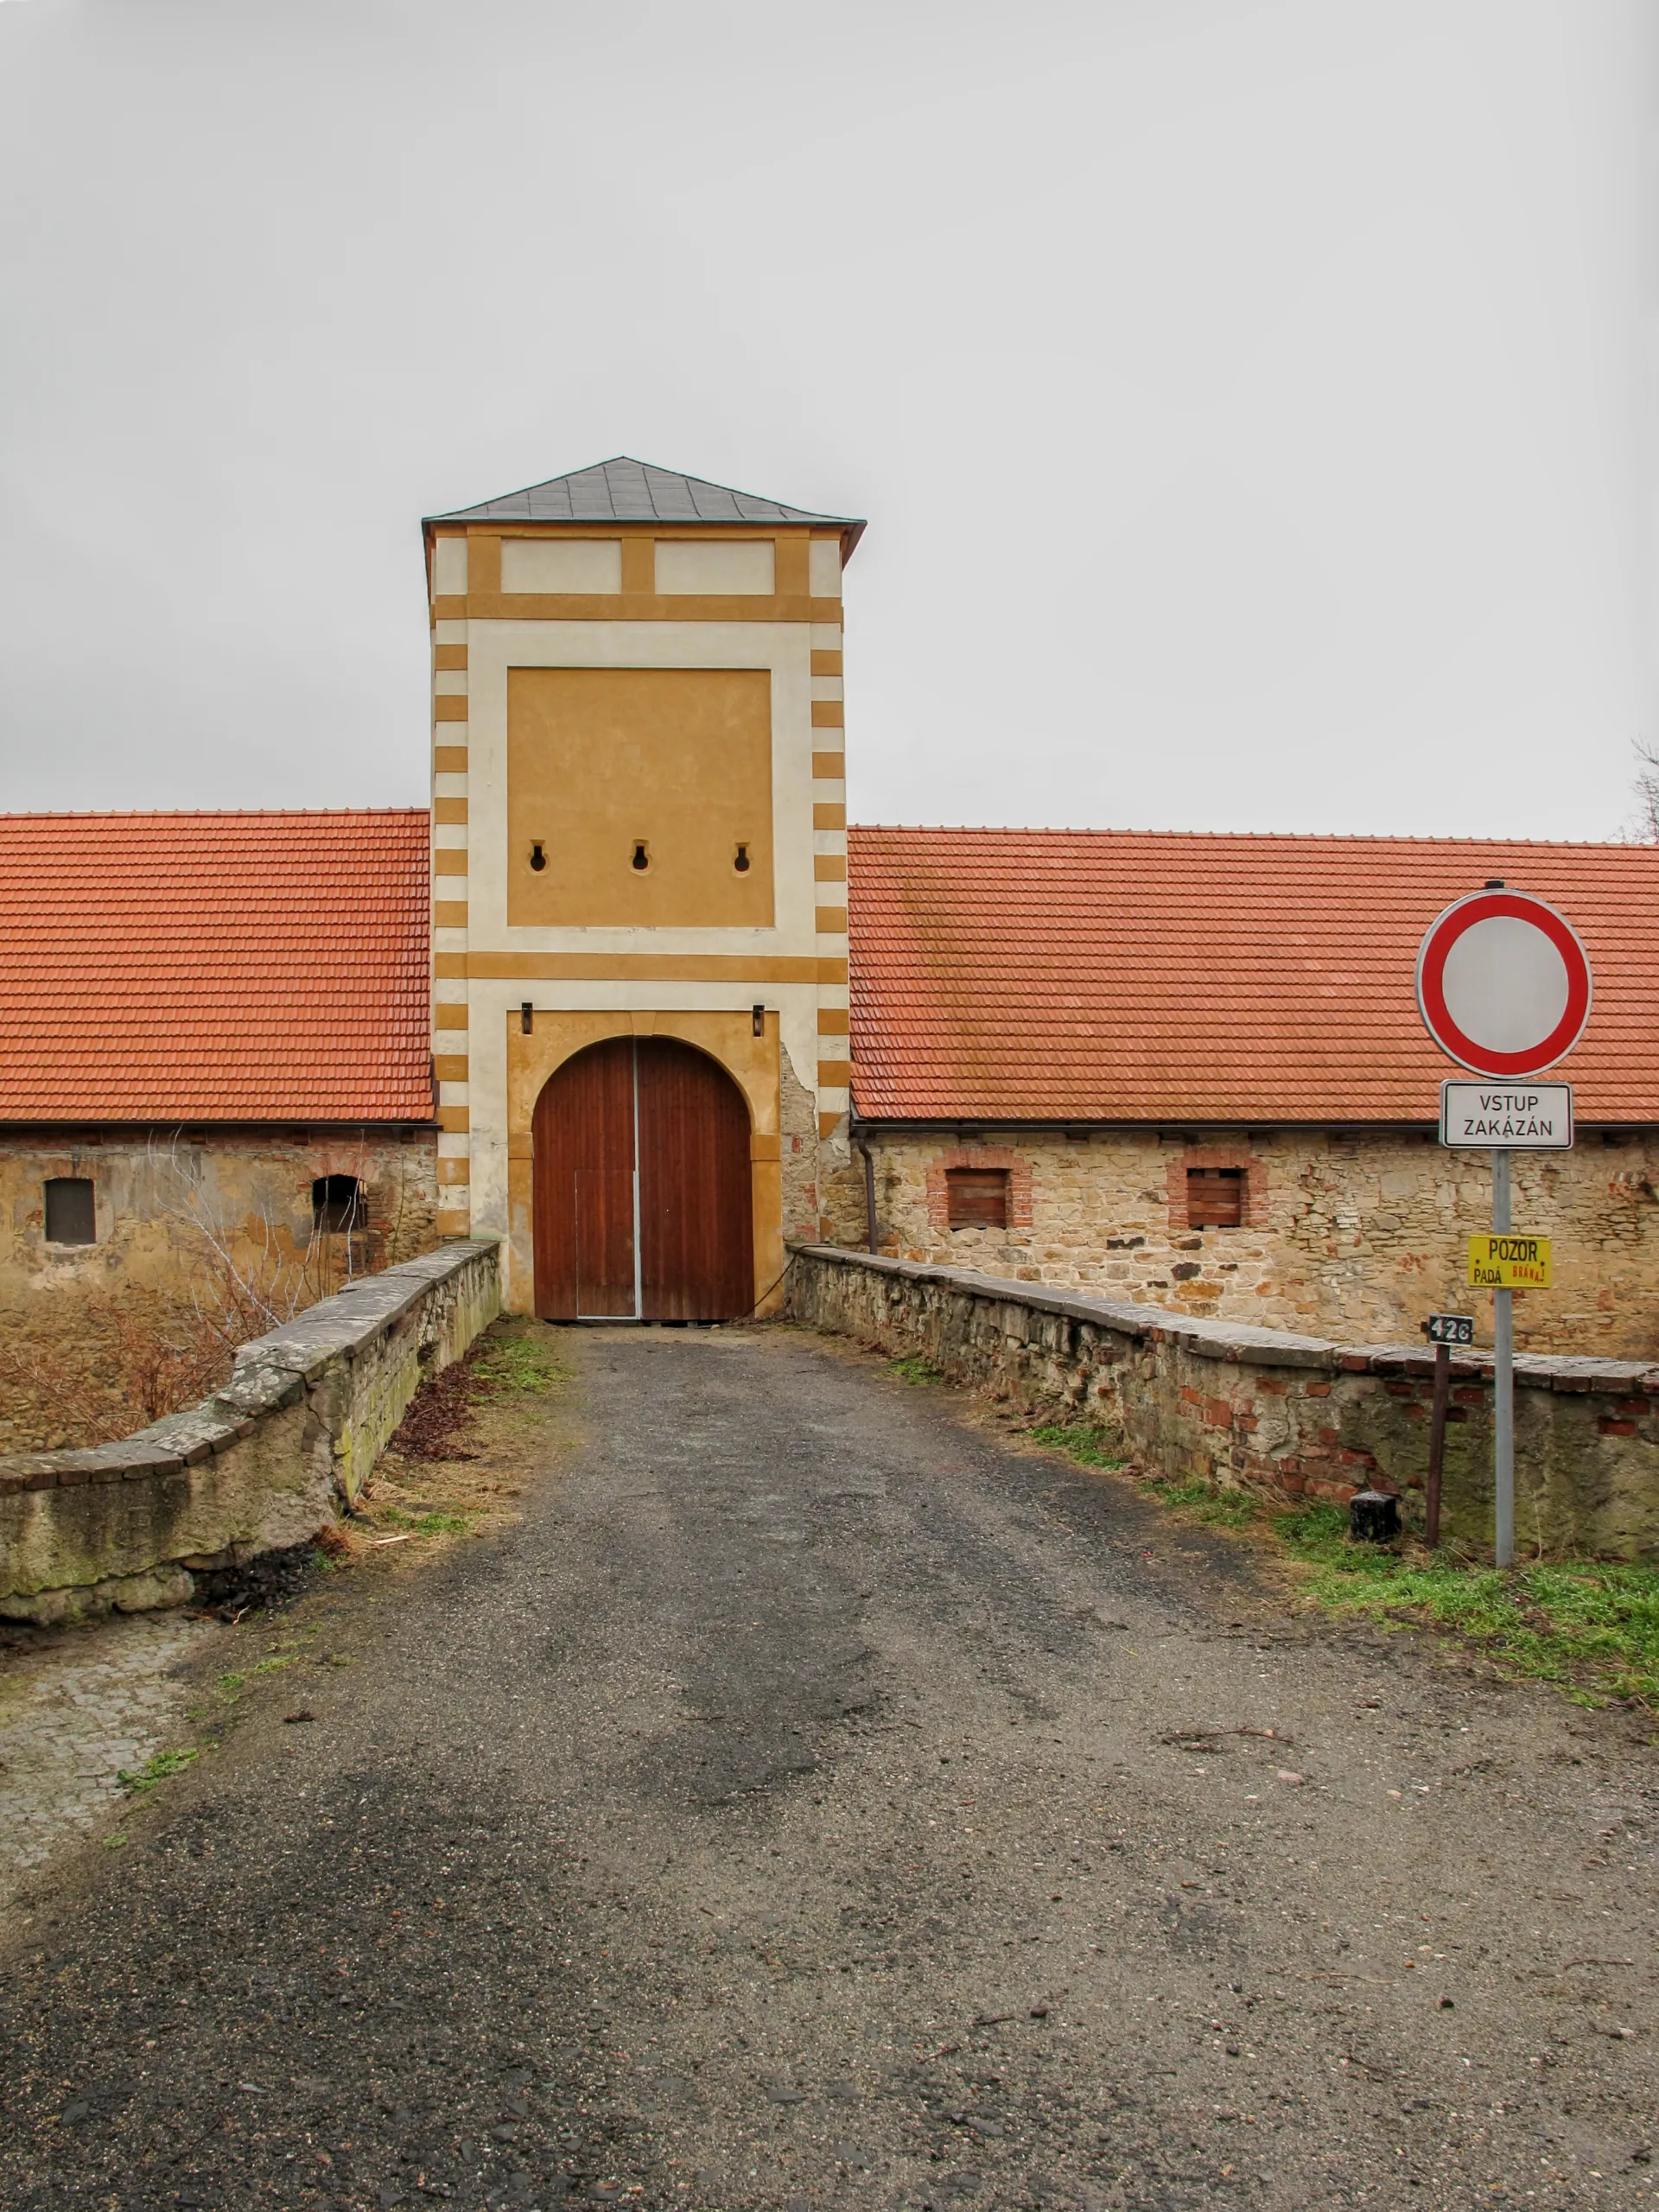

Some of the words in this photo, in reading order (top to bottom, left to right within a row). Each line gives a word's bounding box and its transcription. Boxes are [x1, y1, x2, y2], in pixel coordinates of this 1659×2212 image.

[1479, 1095, 1539, 1111] VSTUP
[1464, 1116, 1553, 1136] ZAKÁZÁN
[1489, 1239, 1538, 1262] POZOR
[1473, 1266, 1502, 1284] PADÁ
